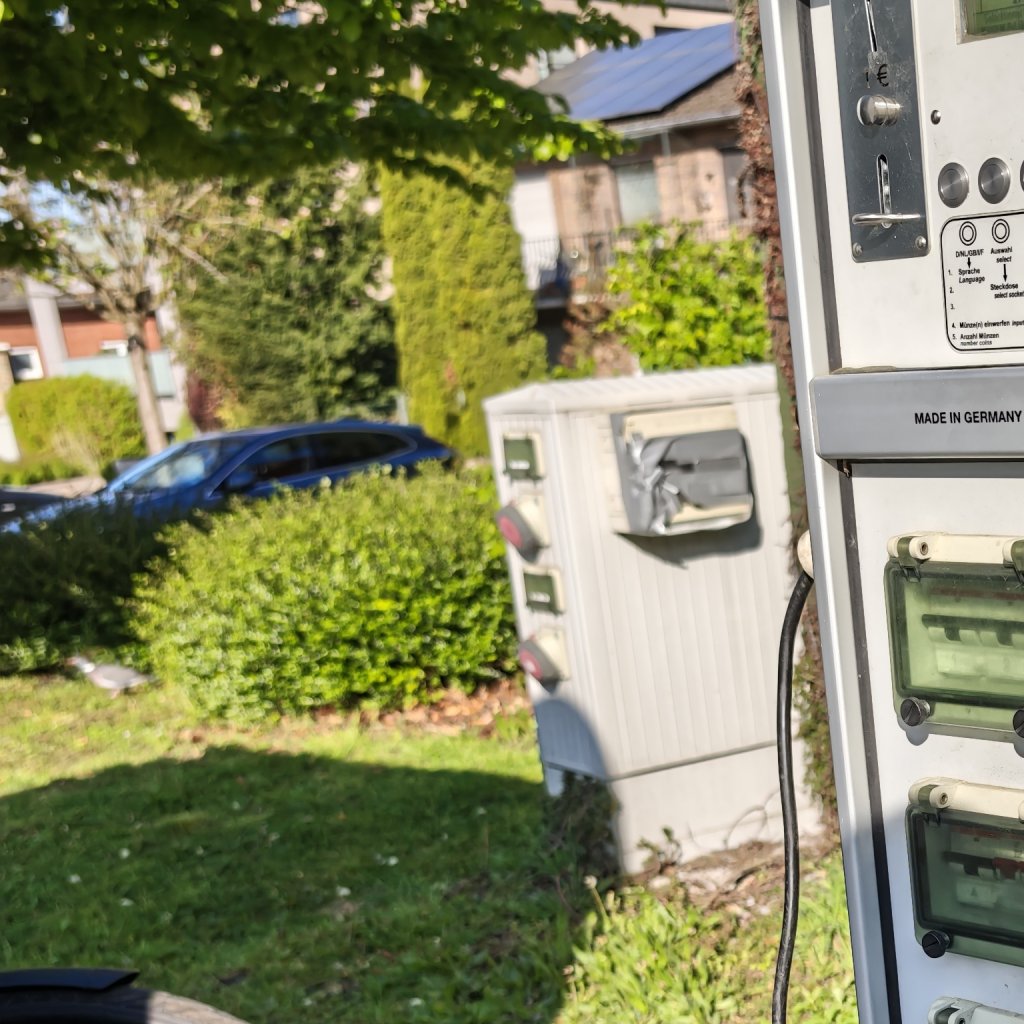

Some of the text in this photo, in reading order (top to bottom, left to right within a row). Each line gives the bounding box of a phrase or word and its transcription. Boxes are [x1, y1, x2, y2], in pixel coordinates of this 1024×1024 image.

[990, 246, 1013, 255] Auswahl
[958, 268, 981, 276] Sprache
[958, 276, 985, 285] Language
[990, 283, 1019, 291] Steckdose
[1009, 290, 1024, 298] socket
[960, 321, 983, 330] Münze(n)
[984, 320, 1010, 328] einwerfen
[914, 410, 1022, 425] MADE IN GERMANY
